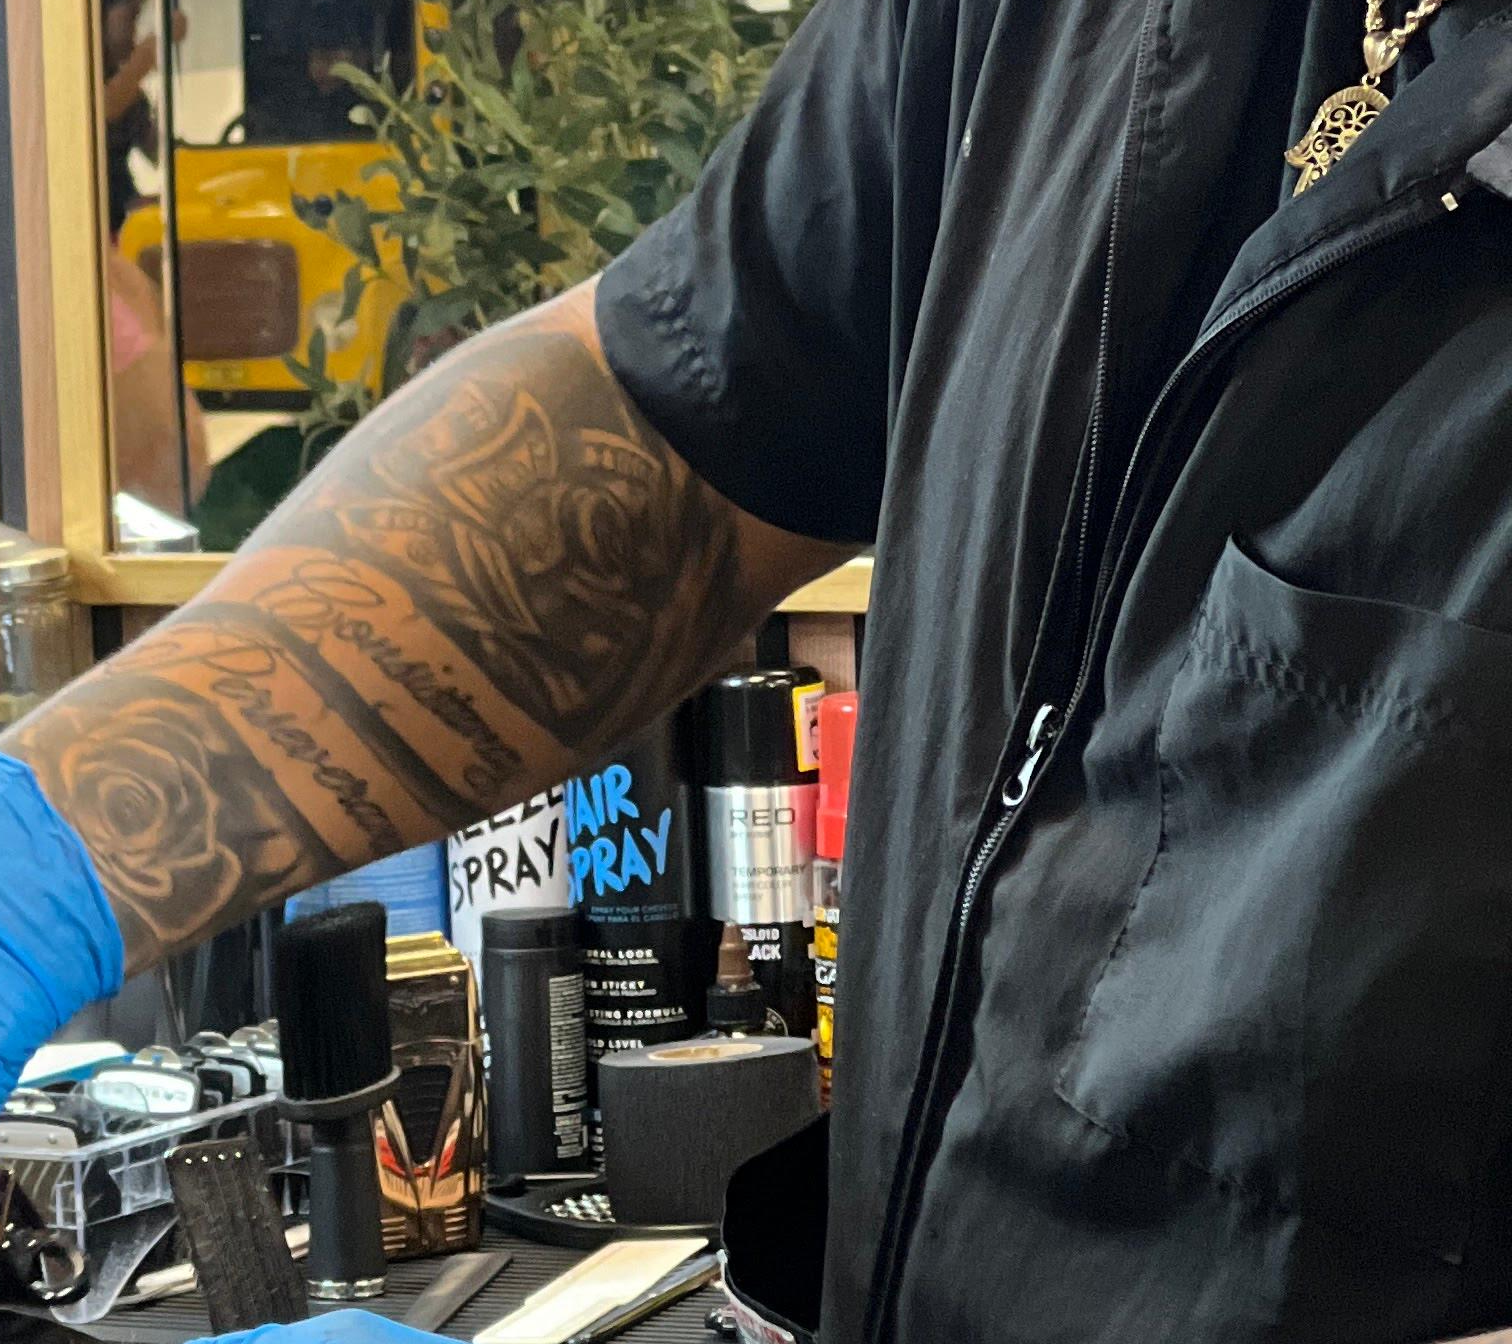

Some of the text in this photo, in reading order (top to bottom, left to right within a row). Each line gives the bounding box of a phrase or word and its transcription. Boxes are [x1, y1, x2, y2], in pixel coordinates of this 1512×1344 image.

[730, 807, 795, 827] RED
[451, 817, 560, 913] SPRAY
[627, 1007, 684, 1019] FORMULA
